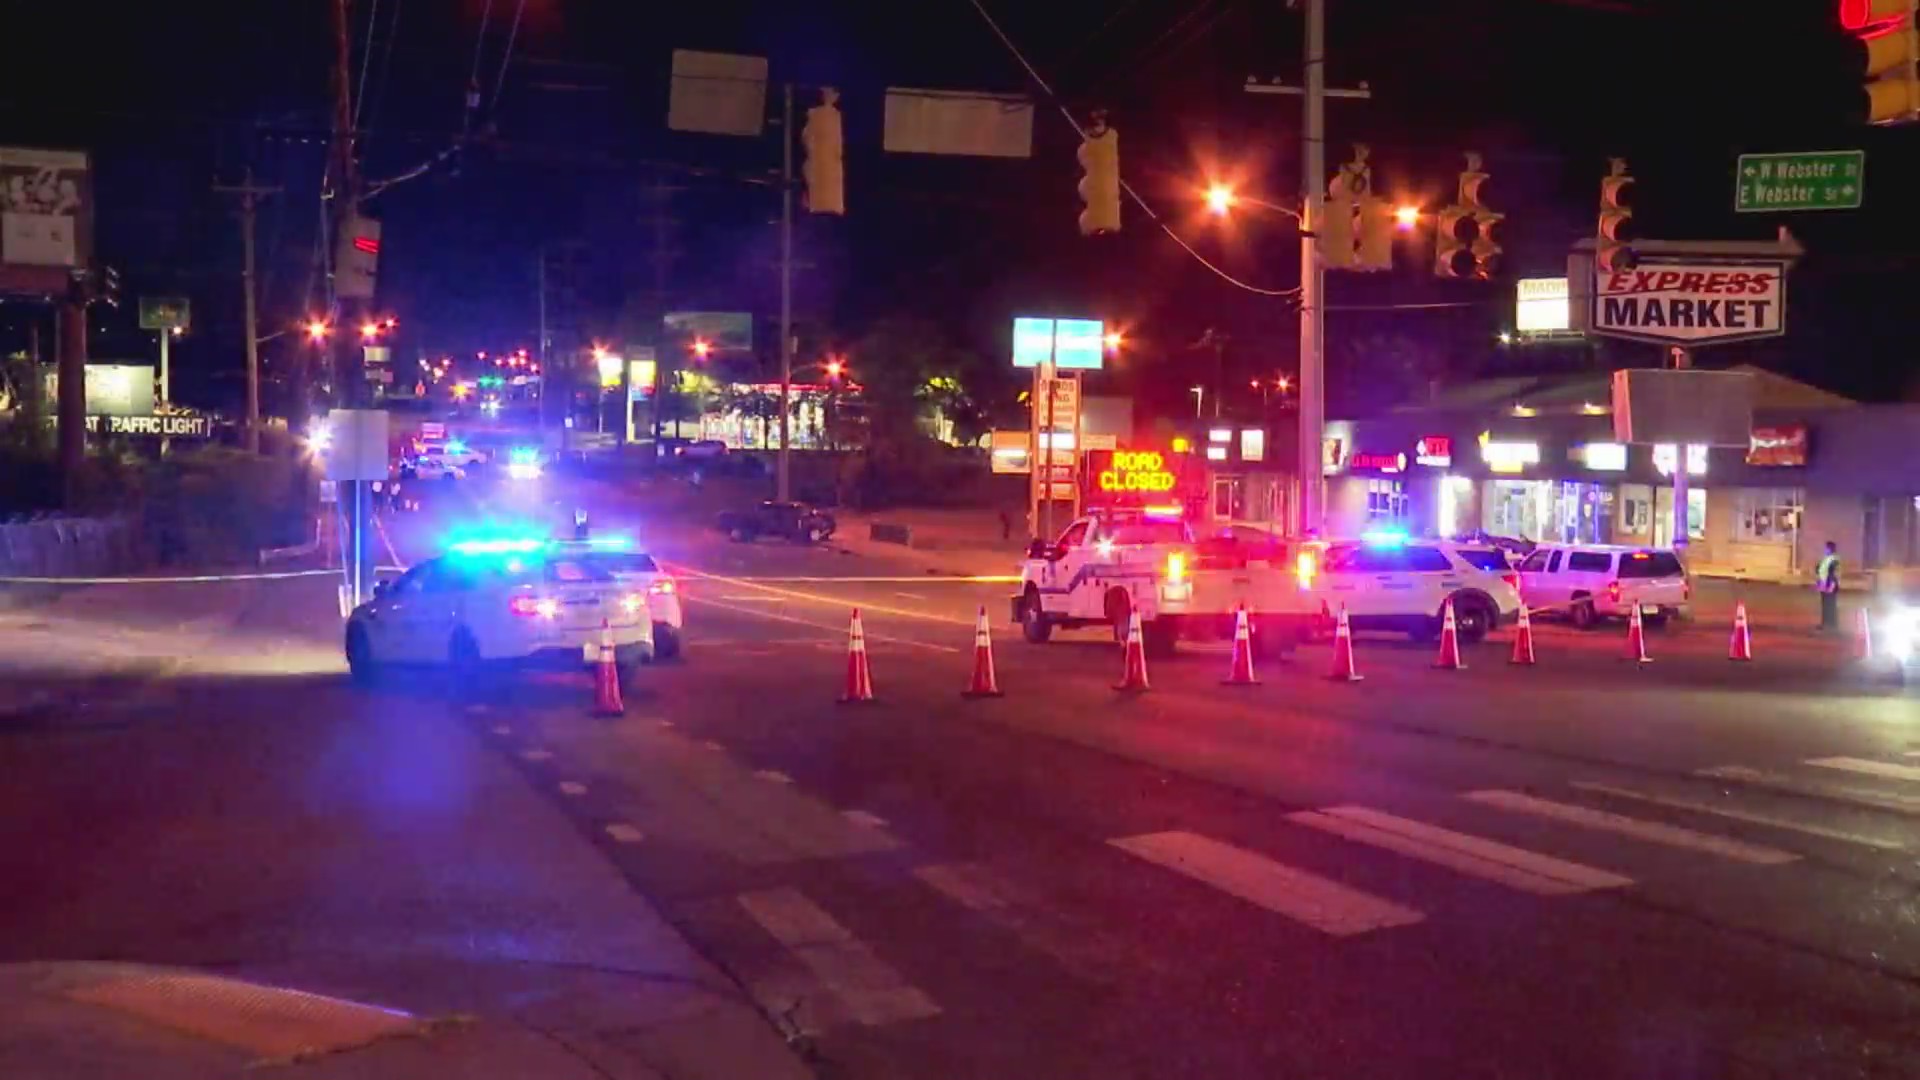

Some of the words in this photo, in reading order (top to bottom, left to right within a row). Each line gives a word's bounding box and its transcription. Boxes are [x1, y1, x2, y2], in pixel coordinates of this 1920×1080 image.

[1778, 163, 1836, 178] Webster
[1741, 185, 1749, 203] E
[1755, 184, 1815, 203] Webster
[1608, 270, 1773, 295] EXPRESS
[1604, 298, 1771, 328] MARKET
[163, 418, 204, 434] LIGHT
[1113, 451, 1162, 470] ROAD
[1100, 471, 1174, 490] CLOSED
